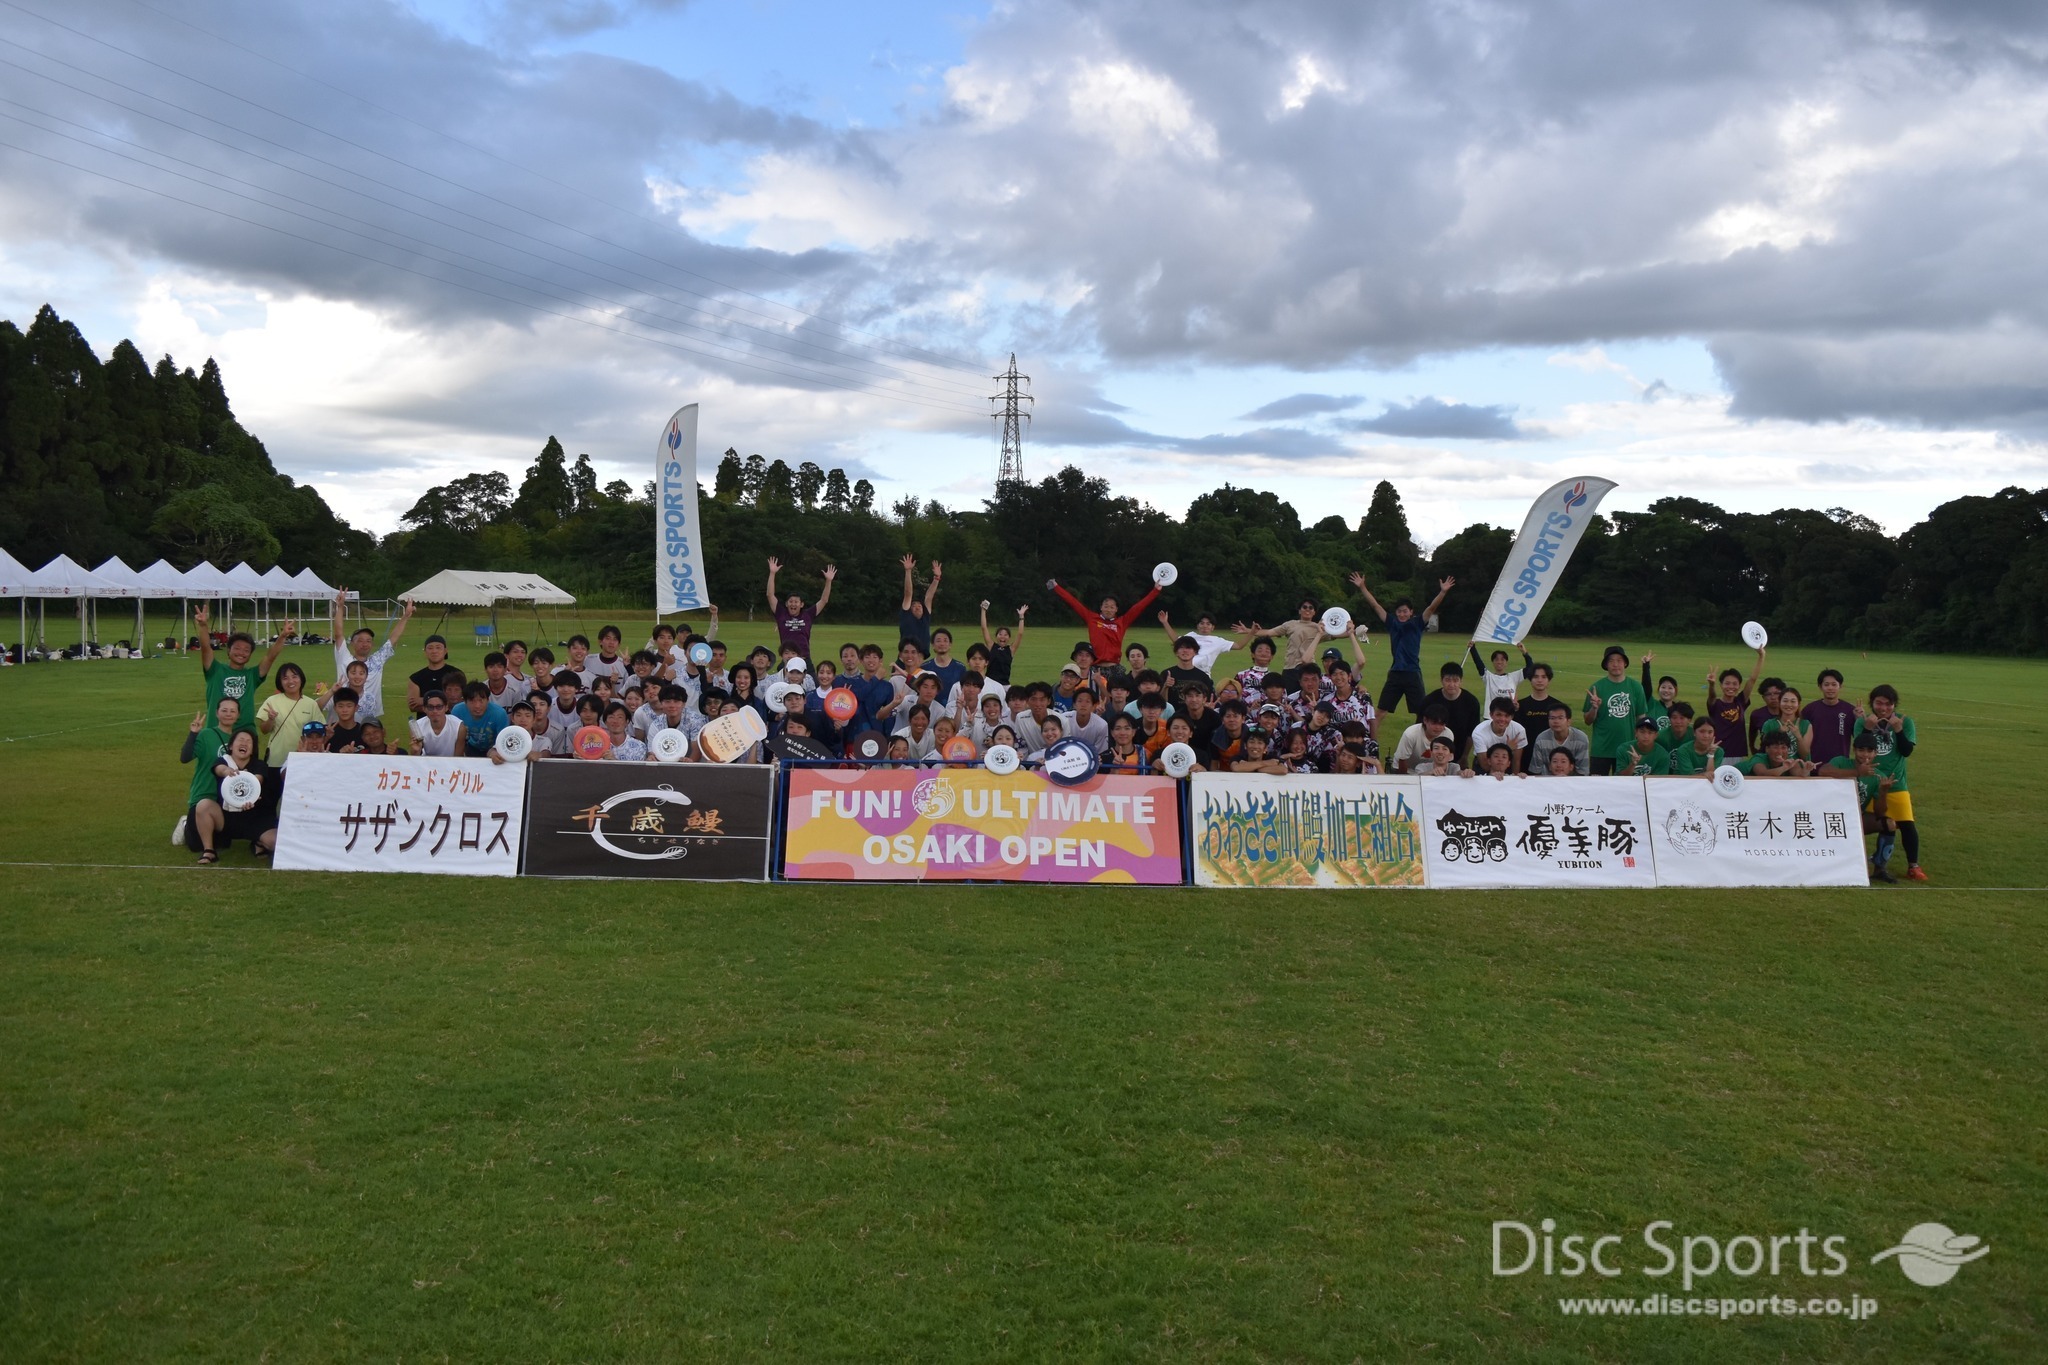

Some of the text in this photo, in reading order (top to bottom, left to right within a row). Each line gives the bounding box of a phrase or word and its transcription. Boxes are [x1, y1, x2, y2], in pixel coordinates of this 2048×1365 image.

[663, 461, 701, 608] DISC SPORTS
[1513, 511, 1572, 599] SPORTS
[377, 768, 484, 794] カフェ・ド・グリル
[571, 804, 725, 835] 千歳鰻
[811, 789, 1155, 824] FUN! ULTIMATE
[1543, 803, 1605, 815] 小野ファーム
[340, 799, 511, 857] サザンクロス
[1202, 789, 1415, 864] おおさき町鰻加工組合
[1443, 820, 1502, 836] ゆうびとん
[1515, 814, 1639, 860] 優美豚
[1680, 822, 1702, 834] 大崎
[1724, 811, 1847, 840] 諸木農園
[638, 837, 720, 845] ちとせうなぎ
[863, 834, 1107, 868] OSAKI OPEN
[1744, 849, 1836, 857] MOROKI NOUEN
[1557, 860, 1603, 869] YUBITON
